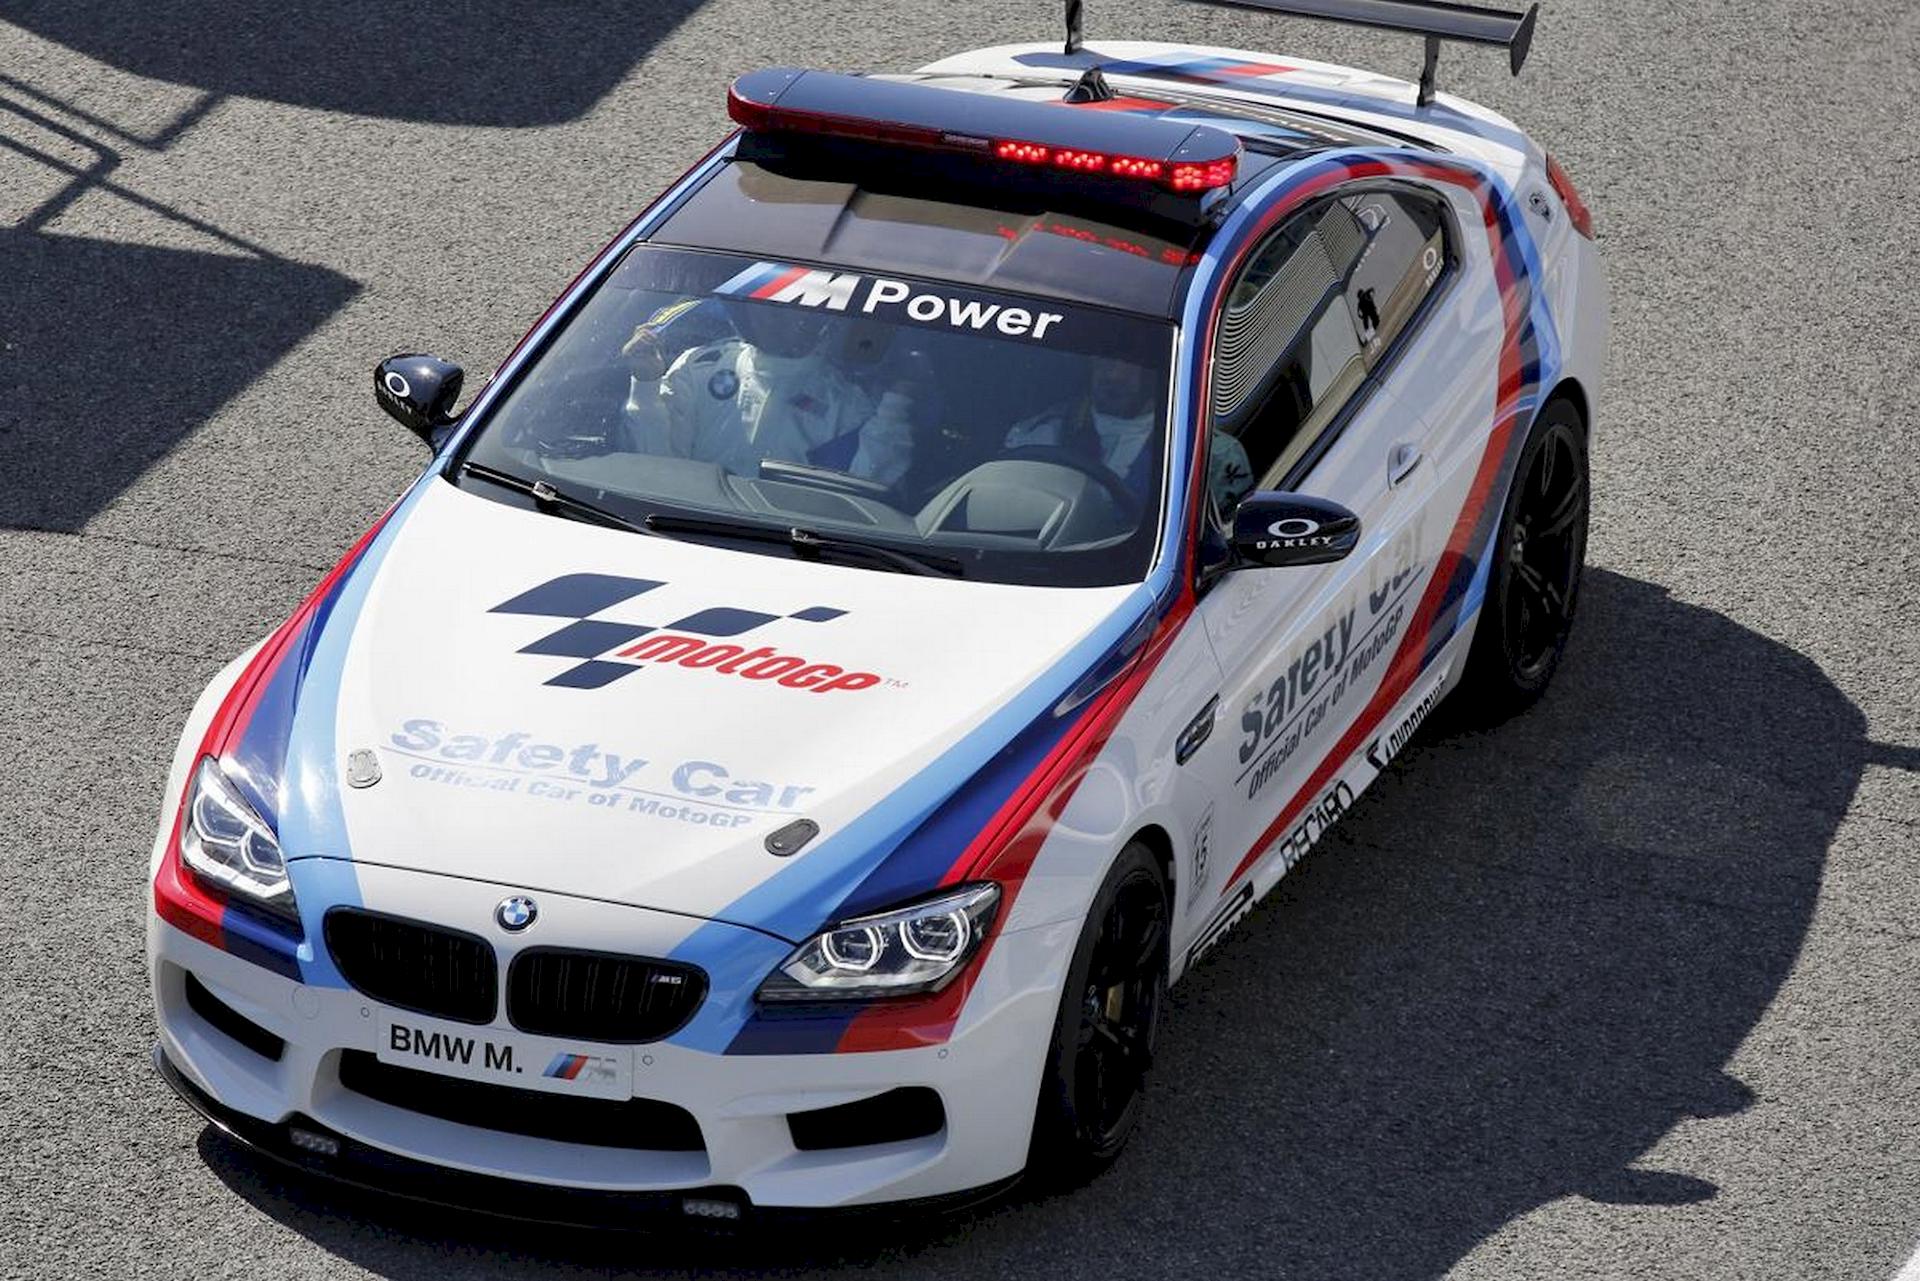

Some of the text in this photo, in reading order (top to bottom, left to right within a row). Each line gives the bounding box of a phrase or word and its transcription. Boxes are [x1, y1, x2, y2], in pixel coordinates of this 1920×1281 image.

[862, 279, 1063, 340] Power
[1256, 536, 1333, 550] OAKLEY
[1249, 604, 1404, 799] Official Car of MotoGP
[391, 719, 816, 808] Safety Car
[528, 780, 581, 800] Car
[588, 792, 627, 808] of
[629, 797, 753, 828] MotoGP
[390, 1023, 523, 1074] BMW M.
